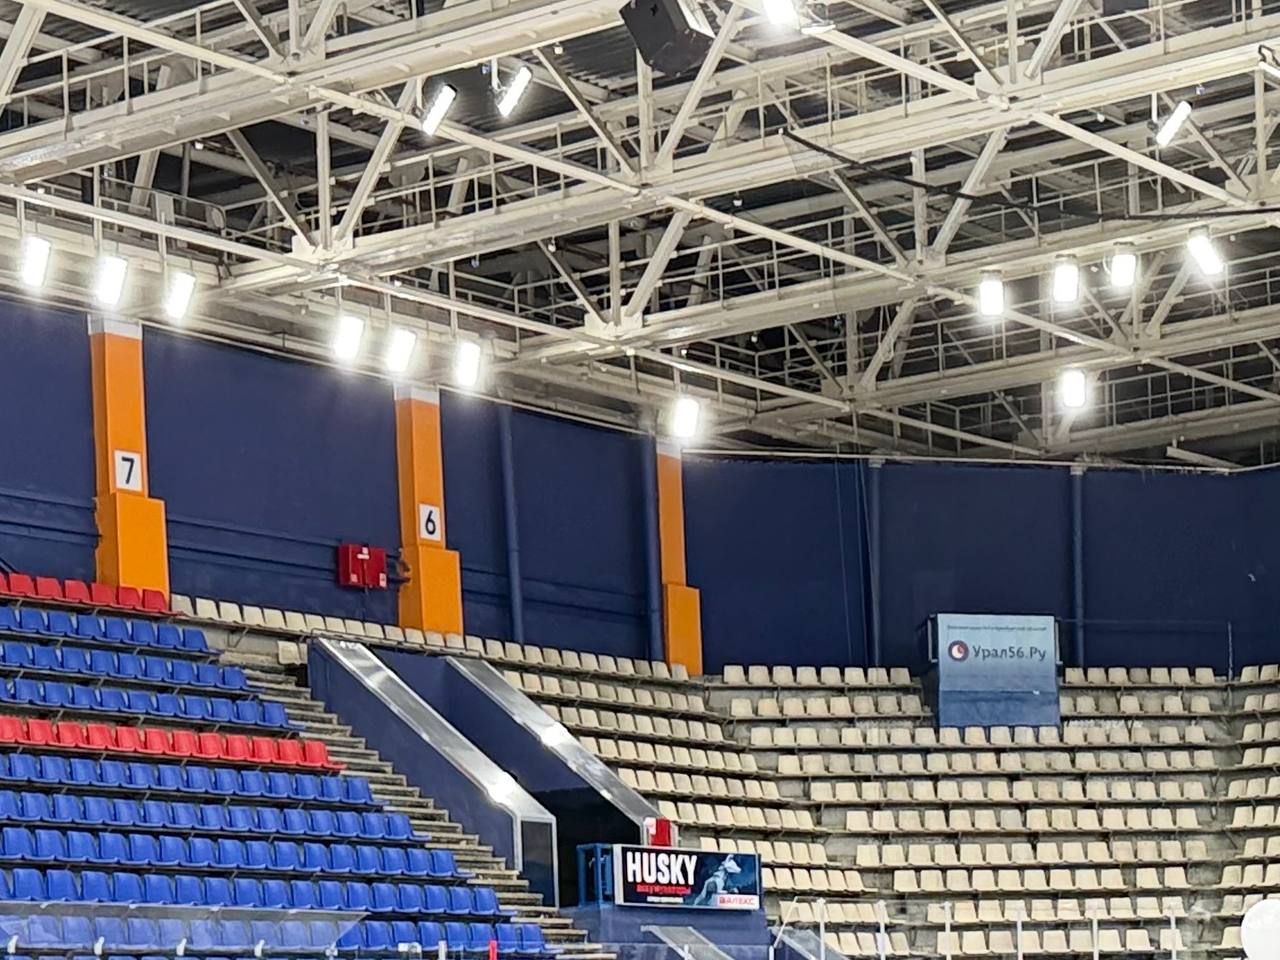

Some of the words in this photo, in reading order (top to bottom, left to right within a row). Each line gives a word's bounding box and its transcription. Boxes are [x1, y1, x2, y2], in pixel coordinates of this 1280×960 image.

[121, 456, 135, 485] 7
[425, 510, 436, 535] 6
[626, 851, 697, 885] HUSKY
